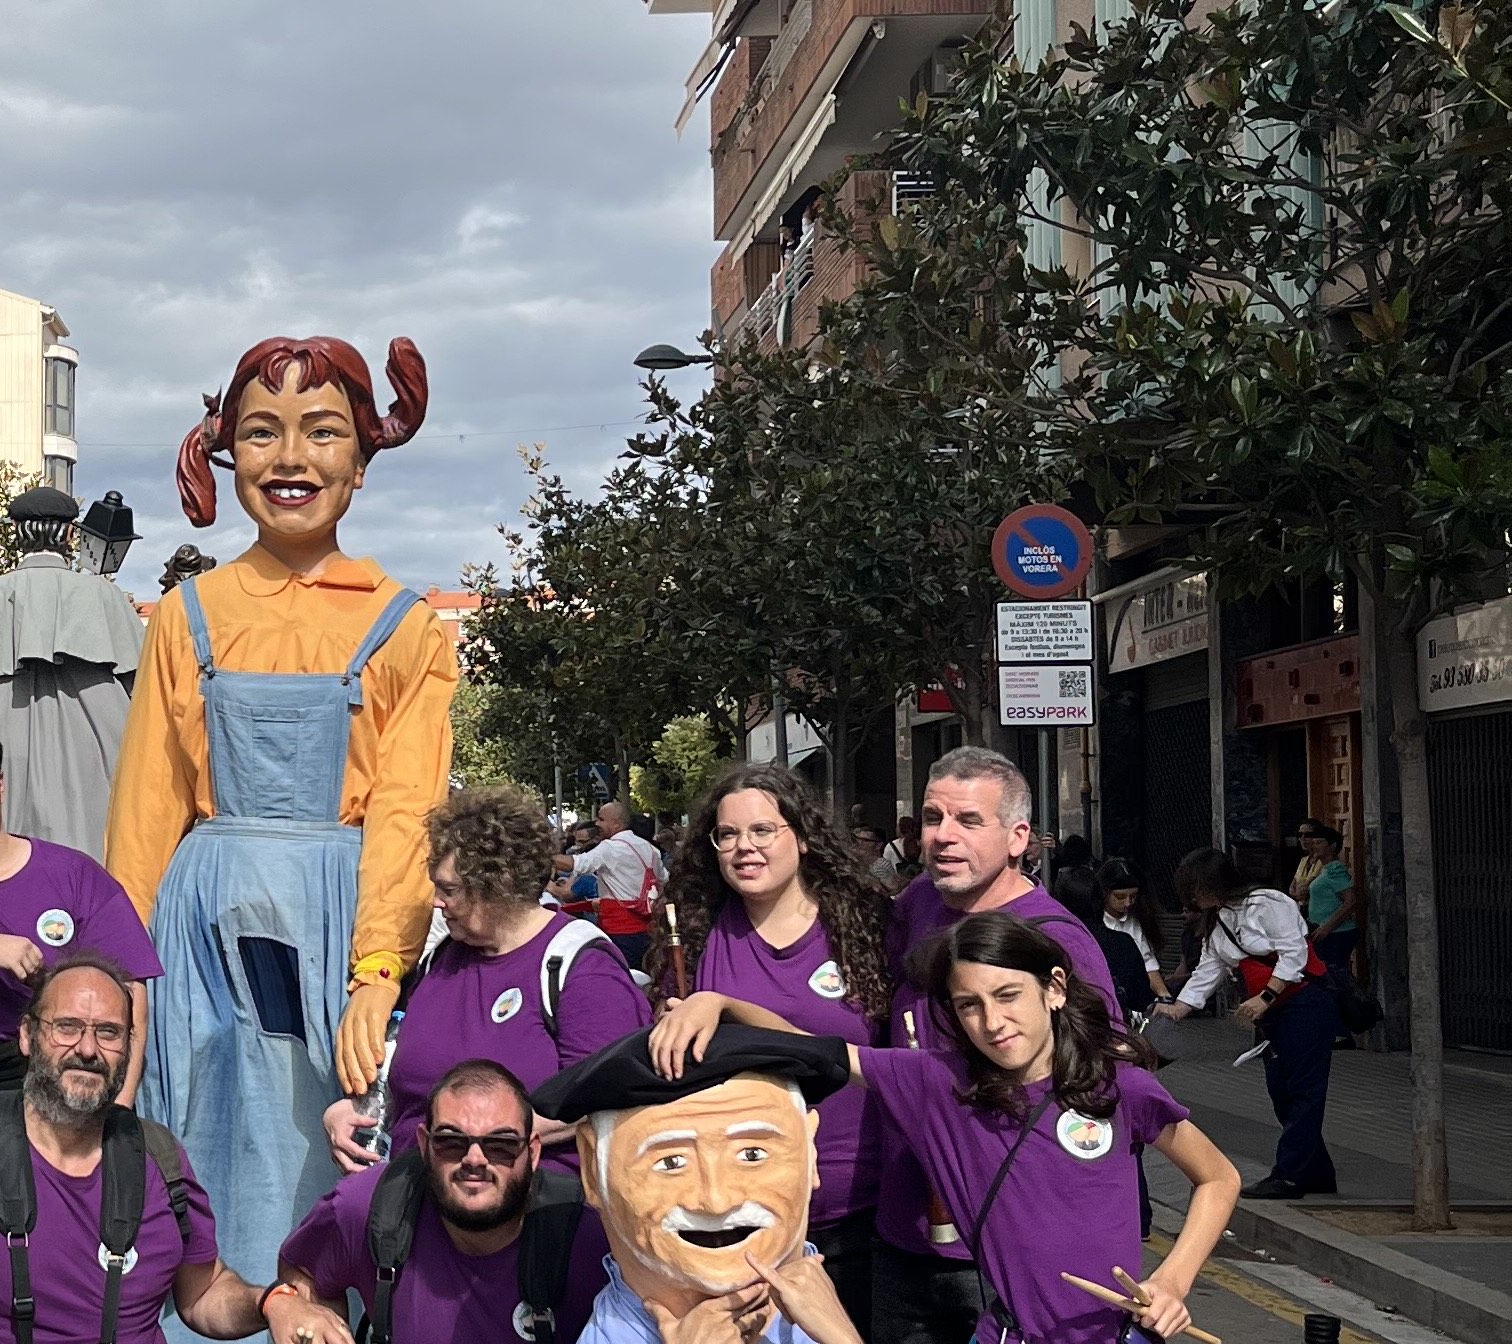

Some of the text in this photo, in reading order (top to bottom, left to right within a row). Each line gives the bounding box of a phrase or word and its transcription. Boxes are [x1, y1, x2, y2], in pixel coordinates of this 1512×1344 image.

[1023, 545, 1055, 555] INCLÒS
[1017, 555, 1062, 564] MOTOS EN
[1022, 564, 1058, 573] VORERA
